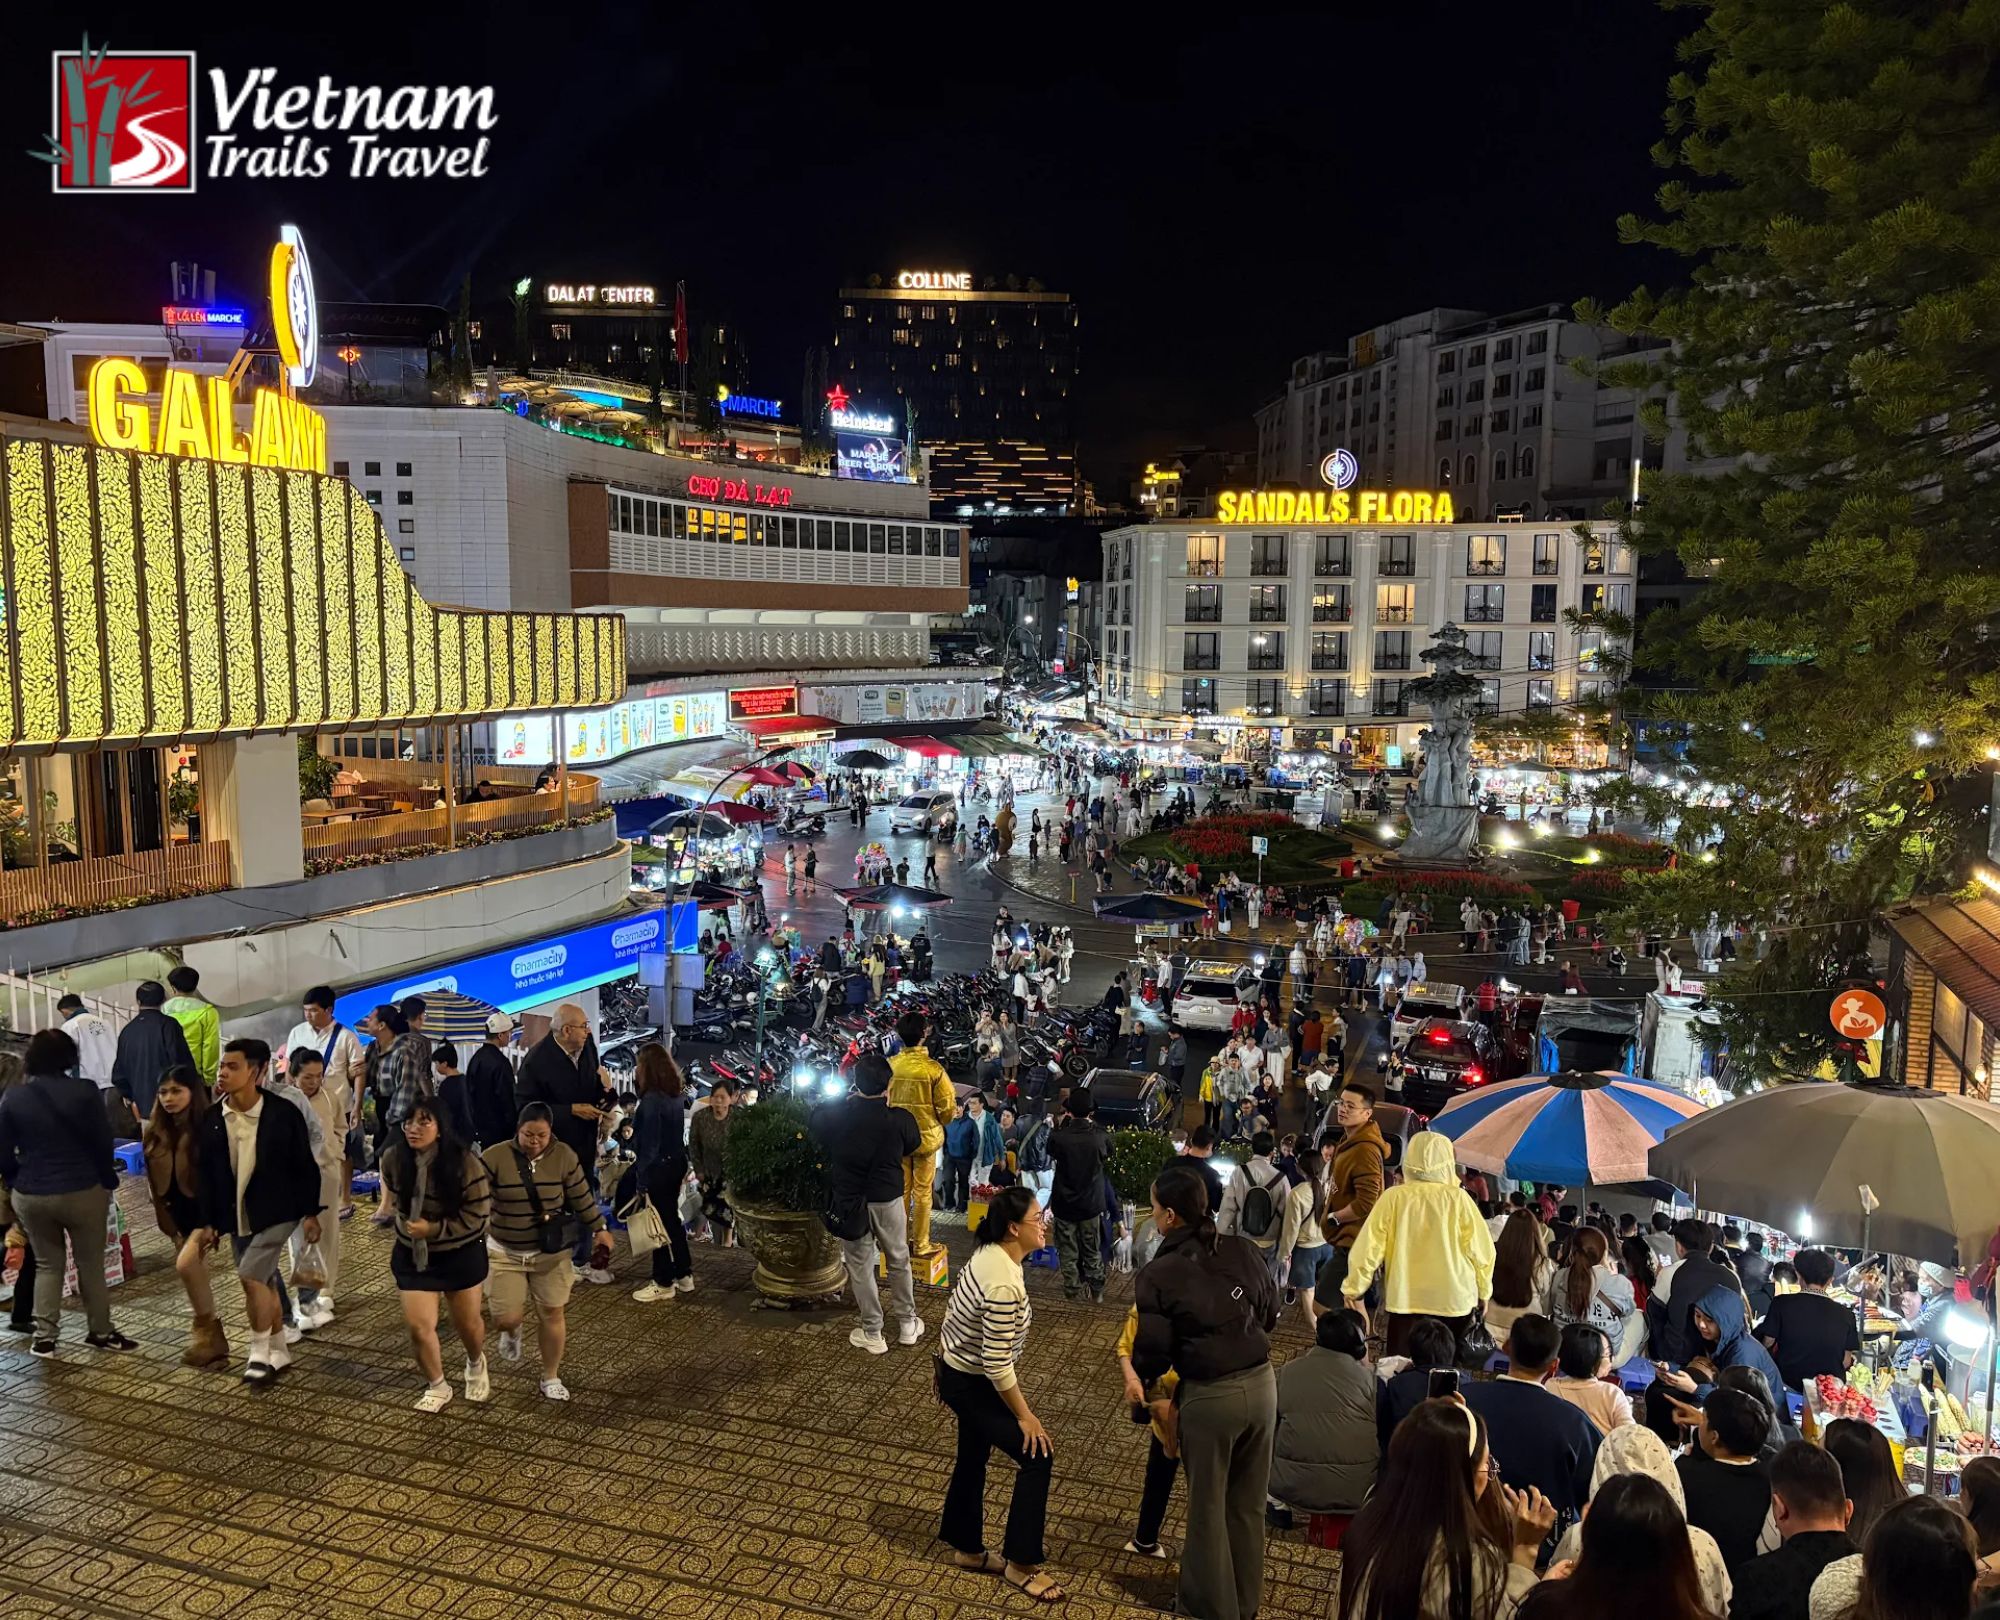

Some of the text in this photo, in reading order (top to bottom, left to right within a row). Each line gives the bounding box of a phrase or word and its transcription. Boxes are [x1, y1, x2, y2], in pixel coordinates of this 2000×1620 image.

[898, 271, 971, 290] COLLINE
[548, 285, 655, 303] DALAT CENTER
[832, 411, 893, 432] Heineken
[688, 475, 792, 507] CHỢ ĐÀ LẠT
[1218, 492, 1453, 523] SANDALS FLORA
[614, 923, 656, 945] Pharmacity
[514, 949, 563, 975] Pharmacity
